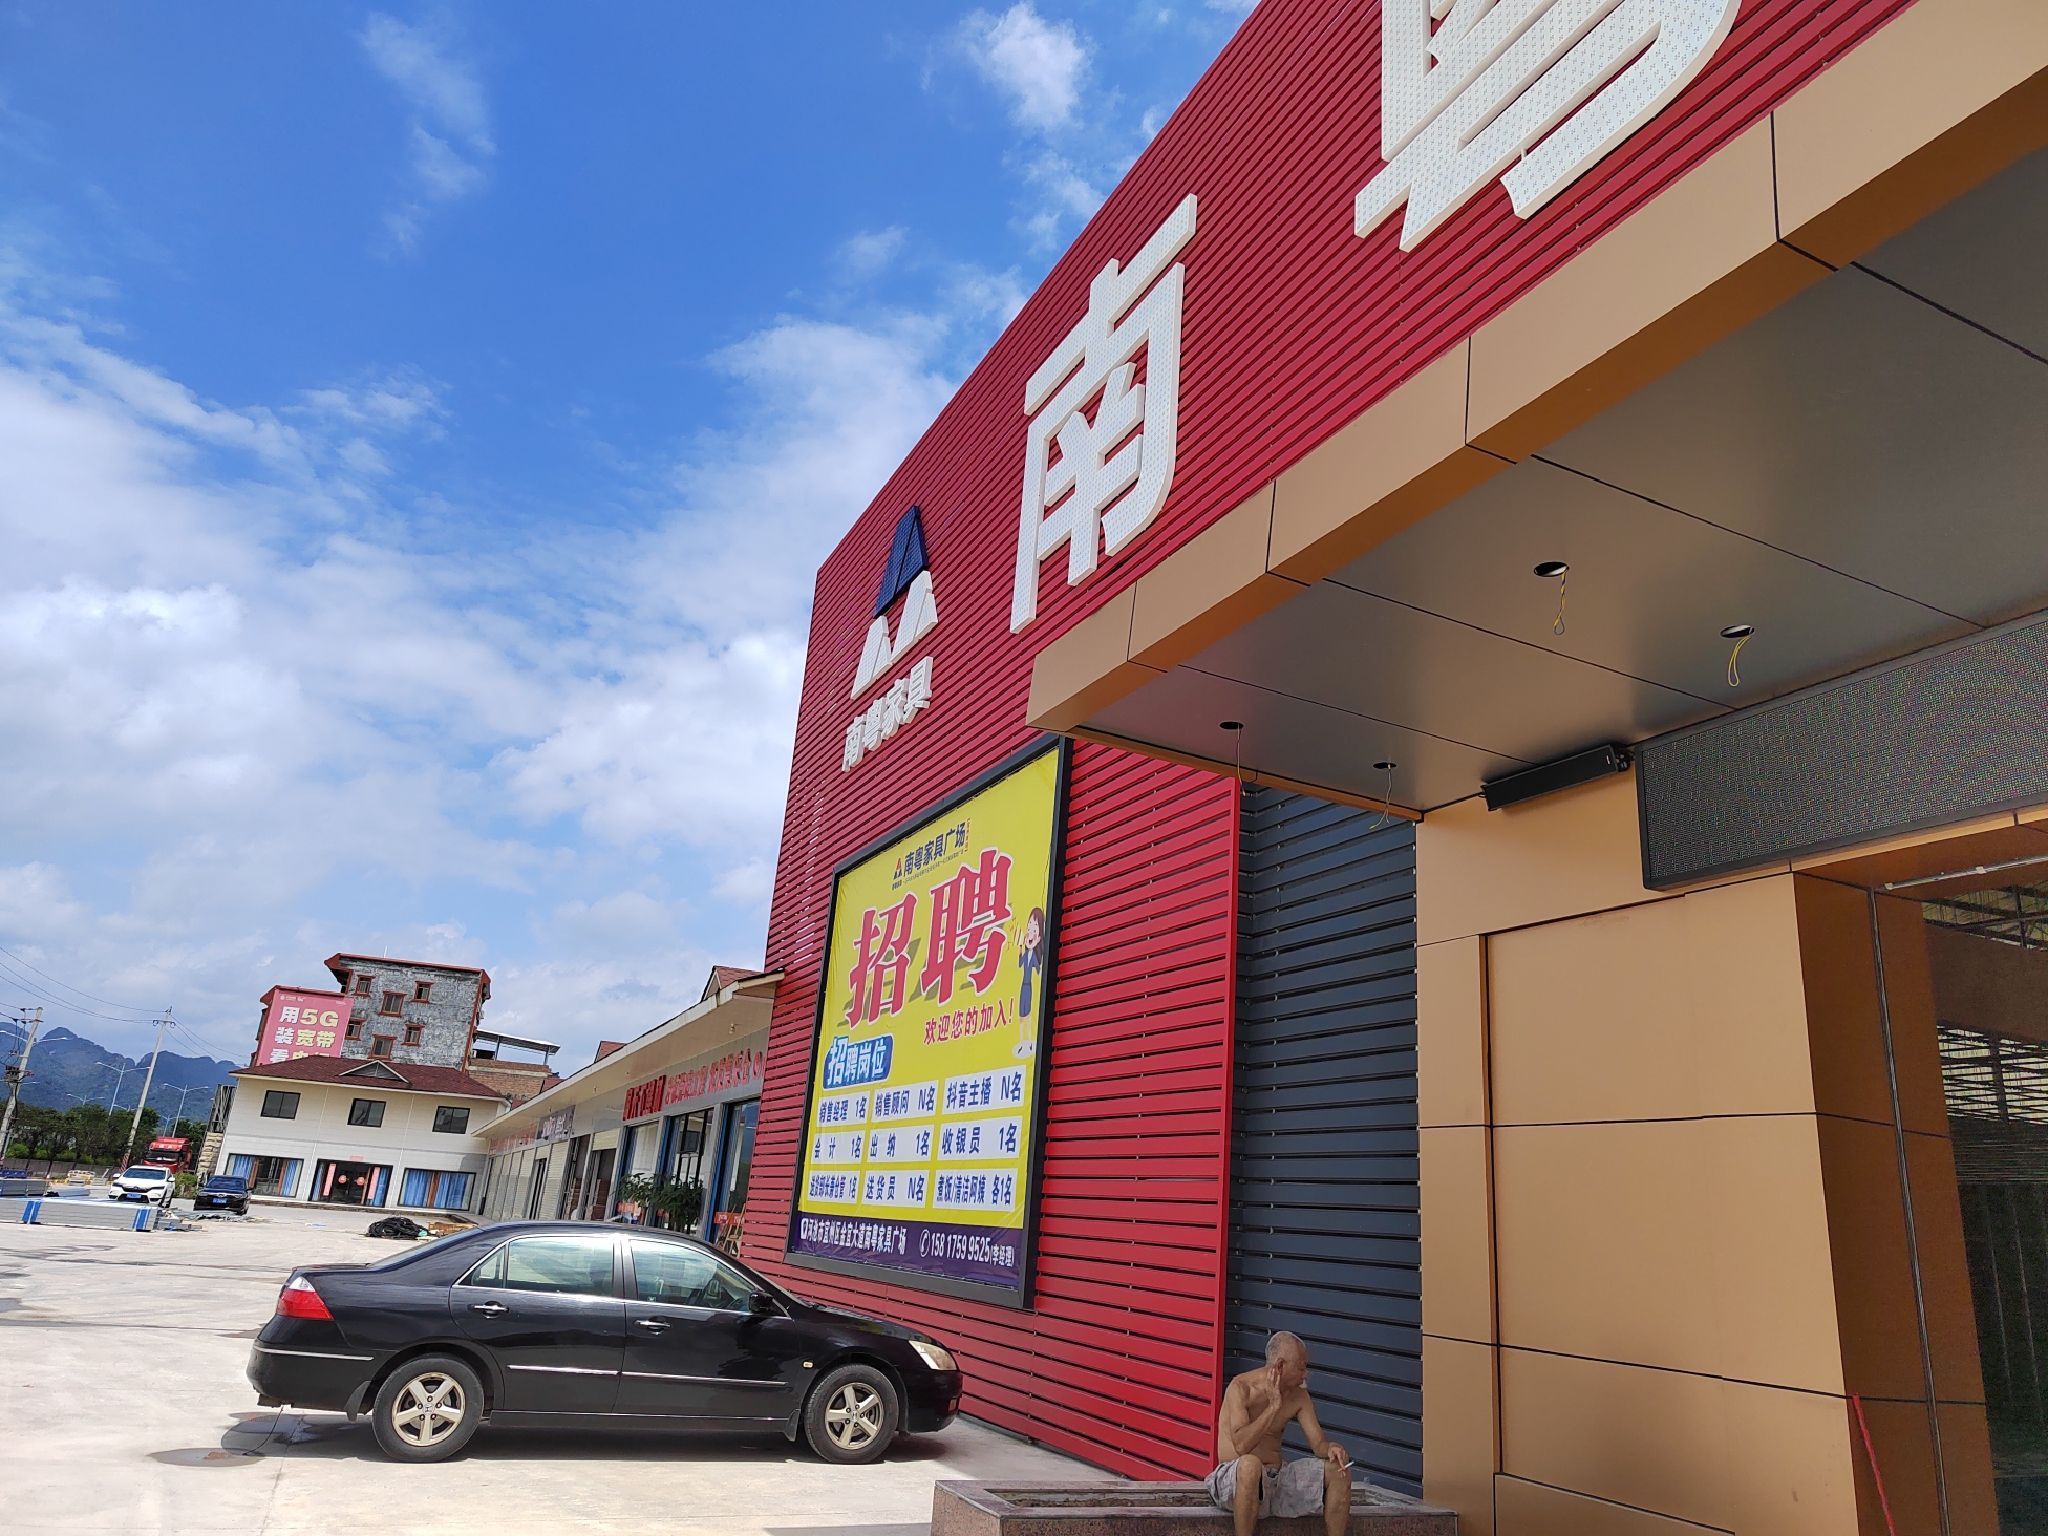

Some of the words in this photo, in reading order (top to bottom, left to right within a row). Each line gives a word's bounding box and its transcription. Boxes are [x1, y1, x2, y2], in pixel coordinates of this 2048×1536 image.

[842, 656, 933, 772] 南粤家具
[903, 822, 966, 877] 南粤家具广场
[846, 848, 1012, 1029] 招聘
[280, 1006, 339, 1028] 用5G
[275, 1026, 336, 1048] 装宽带
[827, 1037, 887, 1086] 招聘岗位
[875, 1090, 910, 1117] 销售顾问
[918, 1085, 935, 1112] N名
[946, 1076, 991, 1109] 抖音主播
[1001, 1071, 1022, 1102] N名
[819, 1100, 849, 1123] 销售经理
[855, 1096, 867, 1119] 1名
[851, 1134, 861, 1158] 1名
[916, 1130, 930, 1156] 1名
[942, 1126, 981, 1155] 收银员
[1000, 1123, 1017, 1153] 1名
[865, 1175, 896, 1201] 送货员
[908, 1175, 924, 1202] N名
[992, 1174, 1012, 1206] 各1名
[931, 1232, 945, 1258] 158
[946, 1234, 967, 1260] 1759
